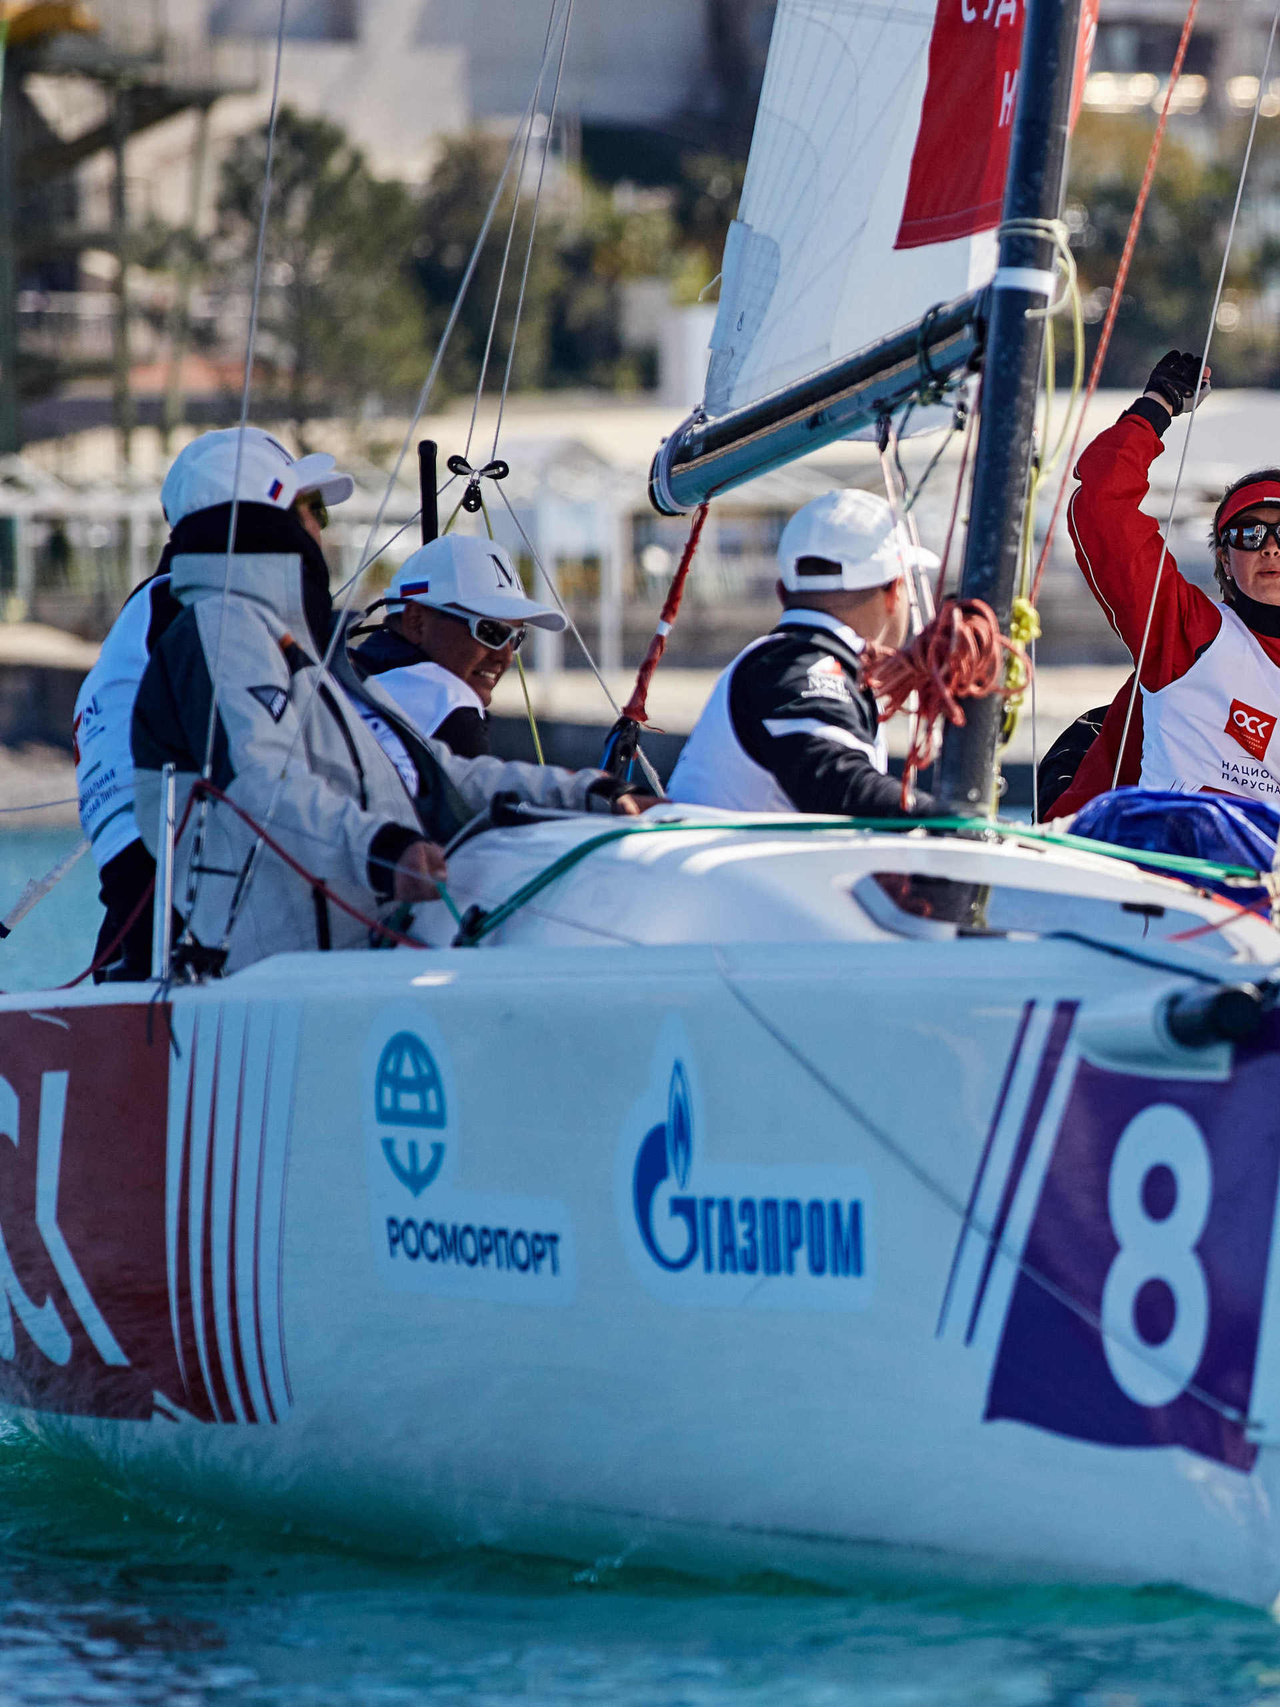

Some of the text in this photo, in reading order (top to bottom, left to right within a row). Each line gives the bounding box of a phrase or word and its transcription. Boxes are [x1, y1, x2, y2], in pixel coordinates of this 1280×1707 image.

[1222, 760, 1274, 780] НАЦИО
[386, 1215, 560, 1277] РОСМОРПОРТ
[701, 1196, 864, 1278] ГАЗПРОМ
[1101, 1103, 1215, 1408] 8
